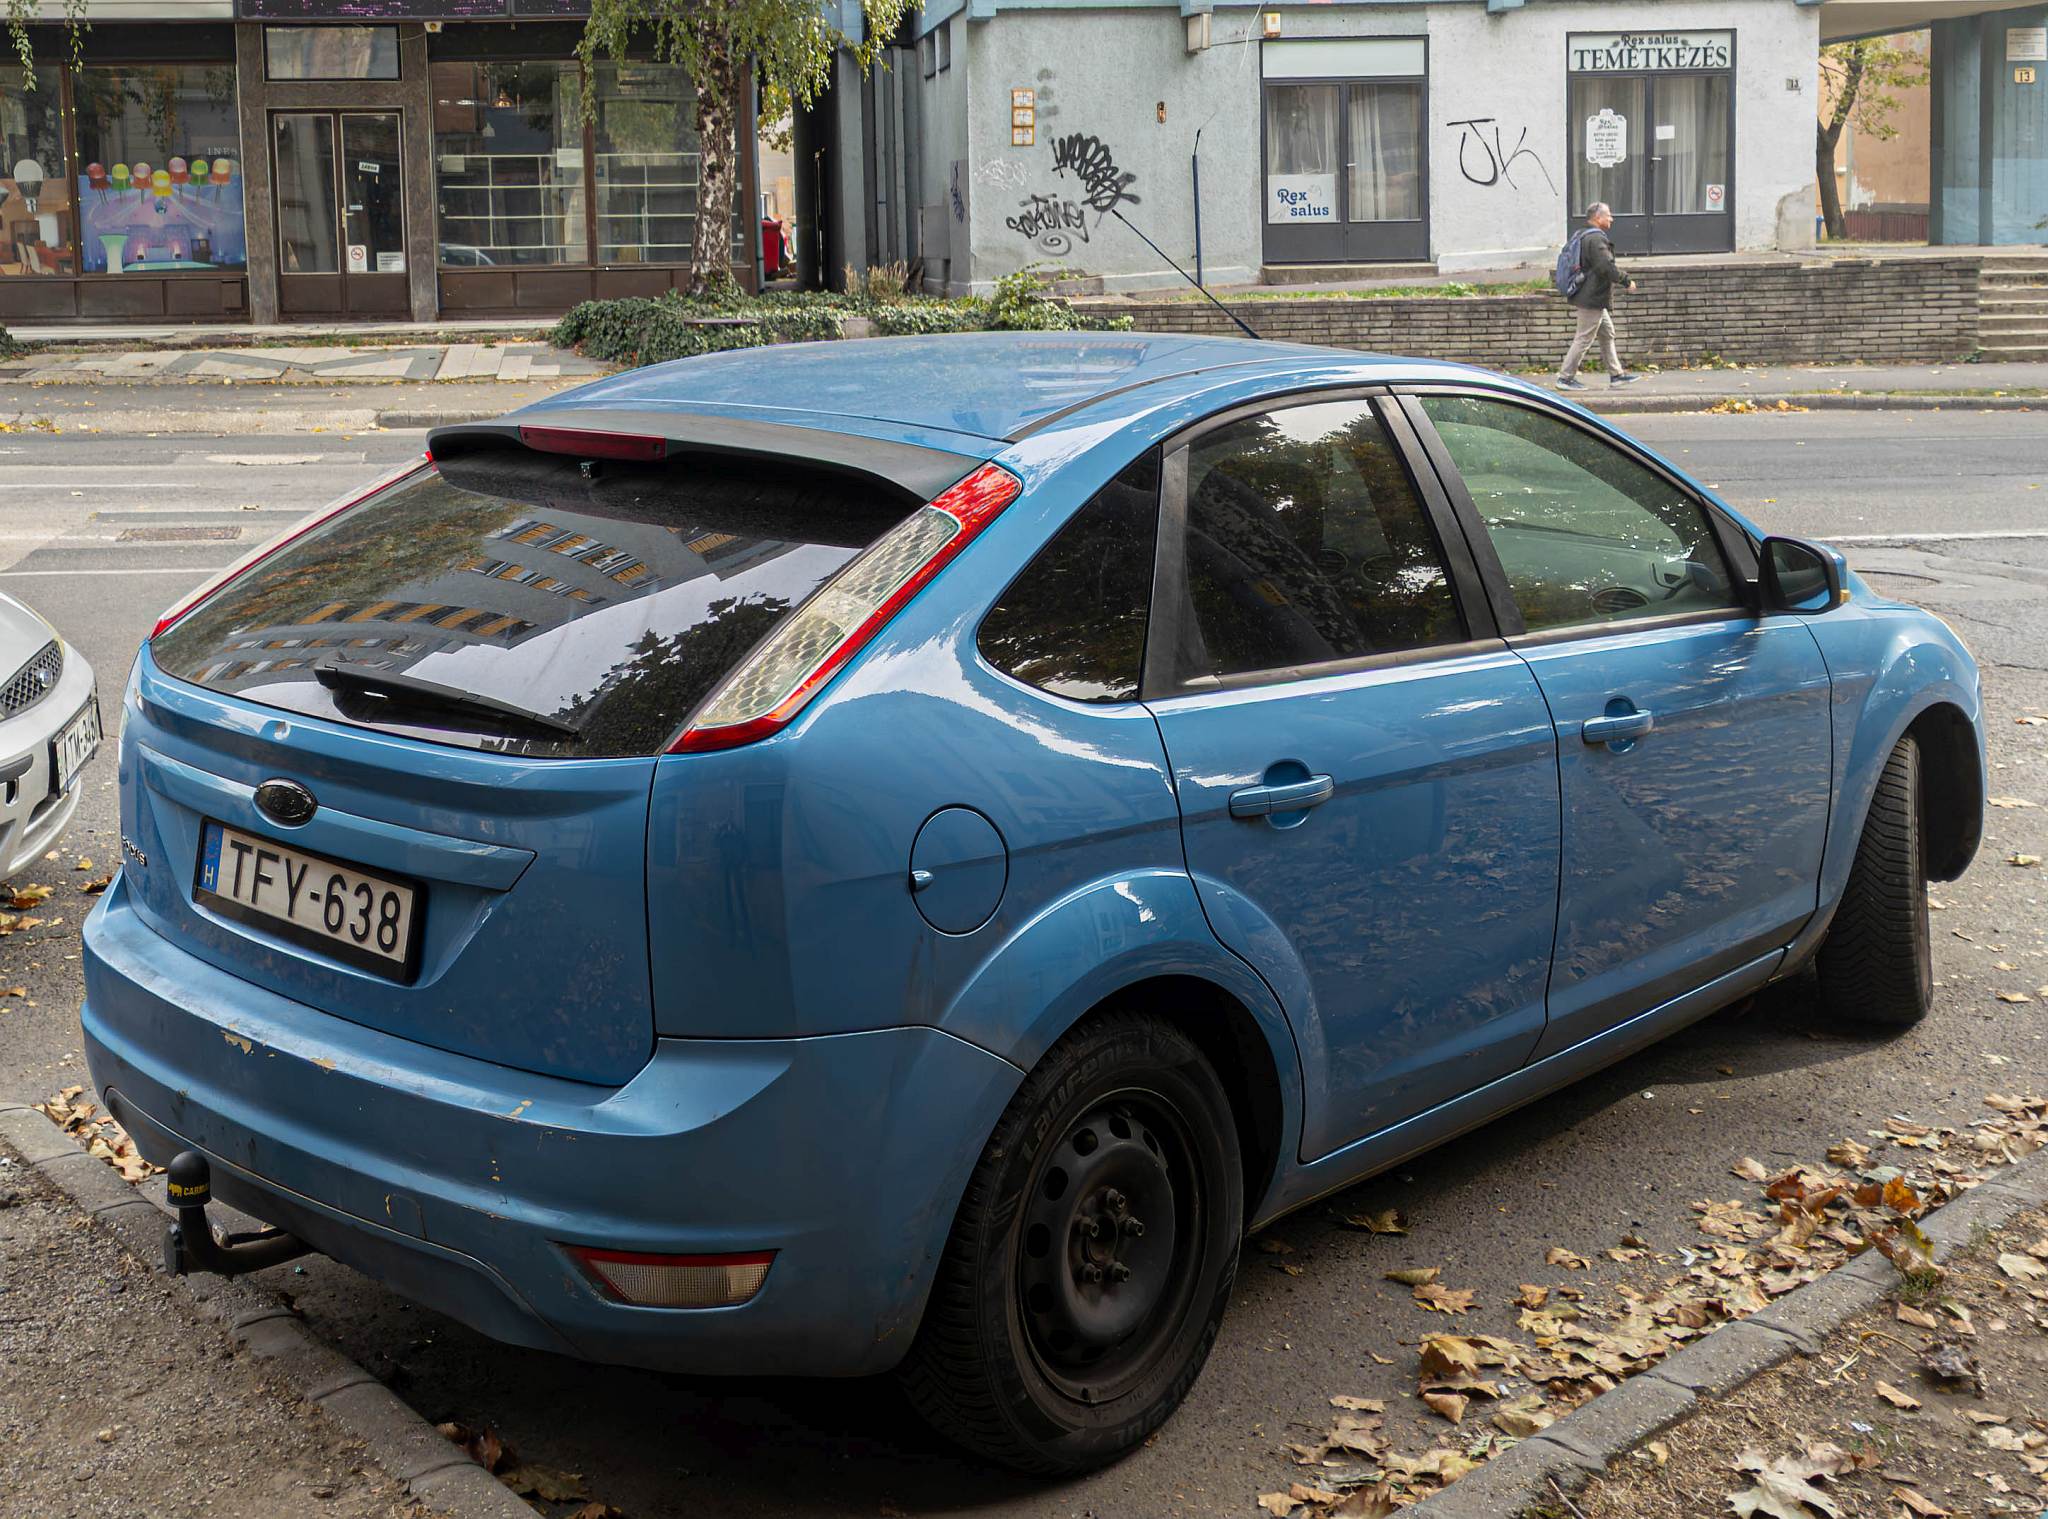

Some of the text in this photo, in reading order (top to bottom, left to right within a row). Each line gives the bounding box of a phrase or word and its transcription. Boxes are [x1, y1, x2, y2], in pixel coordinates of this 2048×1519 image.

[1621, 34, 1679, 51] Rex salus
[1574, 40, 1728, 69] TEMETKEZÉS
[2020, 71, 2030, 82] 13
[1277, 188, 1307, 205] Rex
[1290, 203, 1329, 216] salus
[203, 839, 401, 953] H TFY-638
